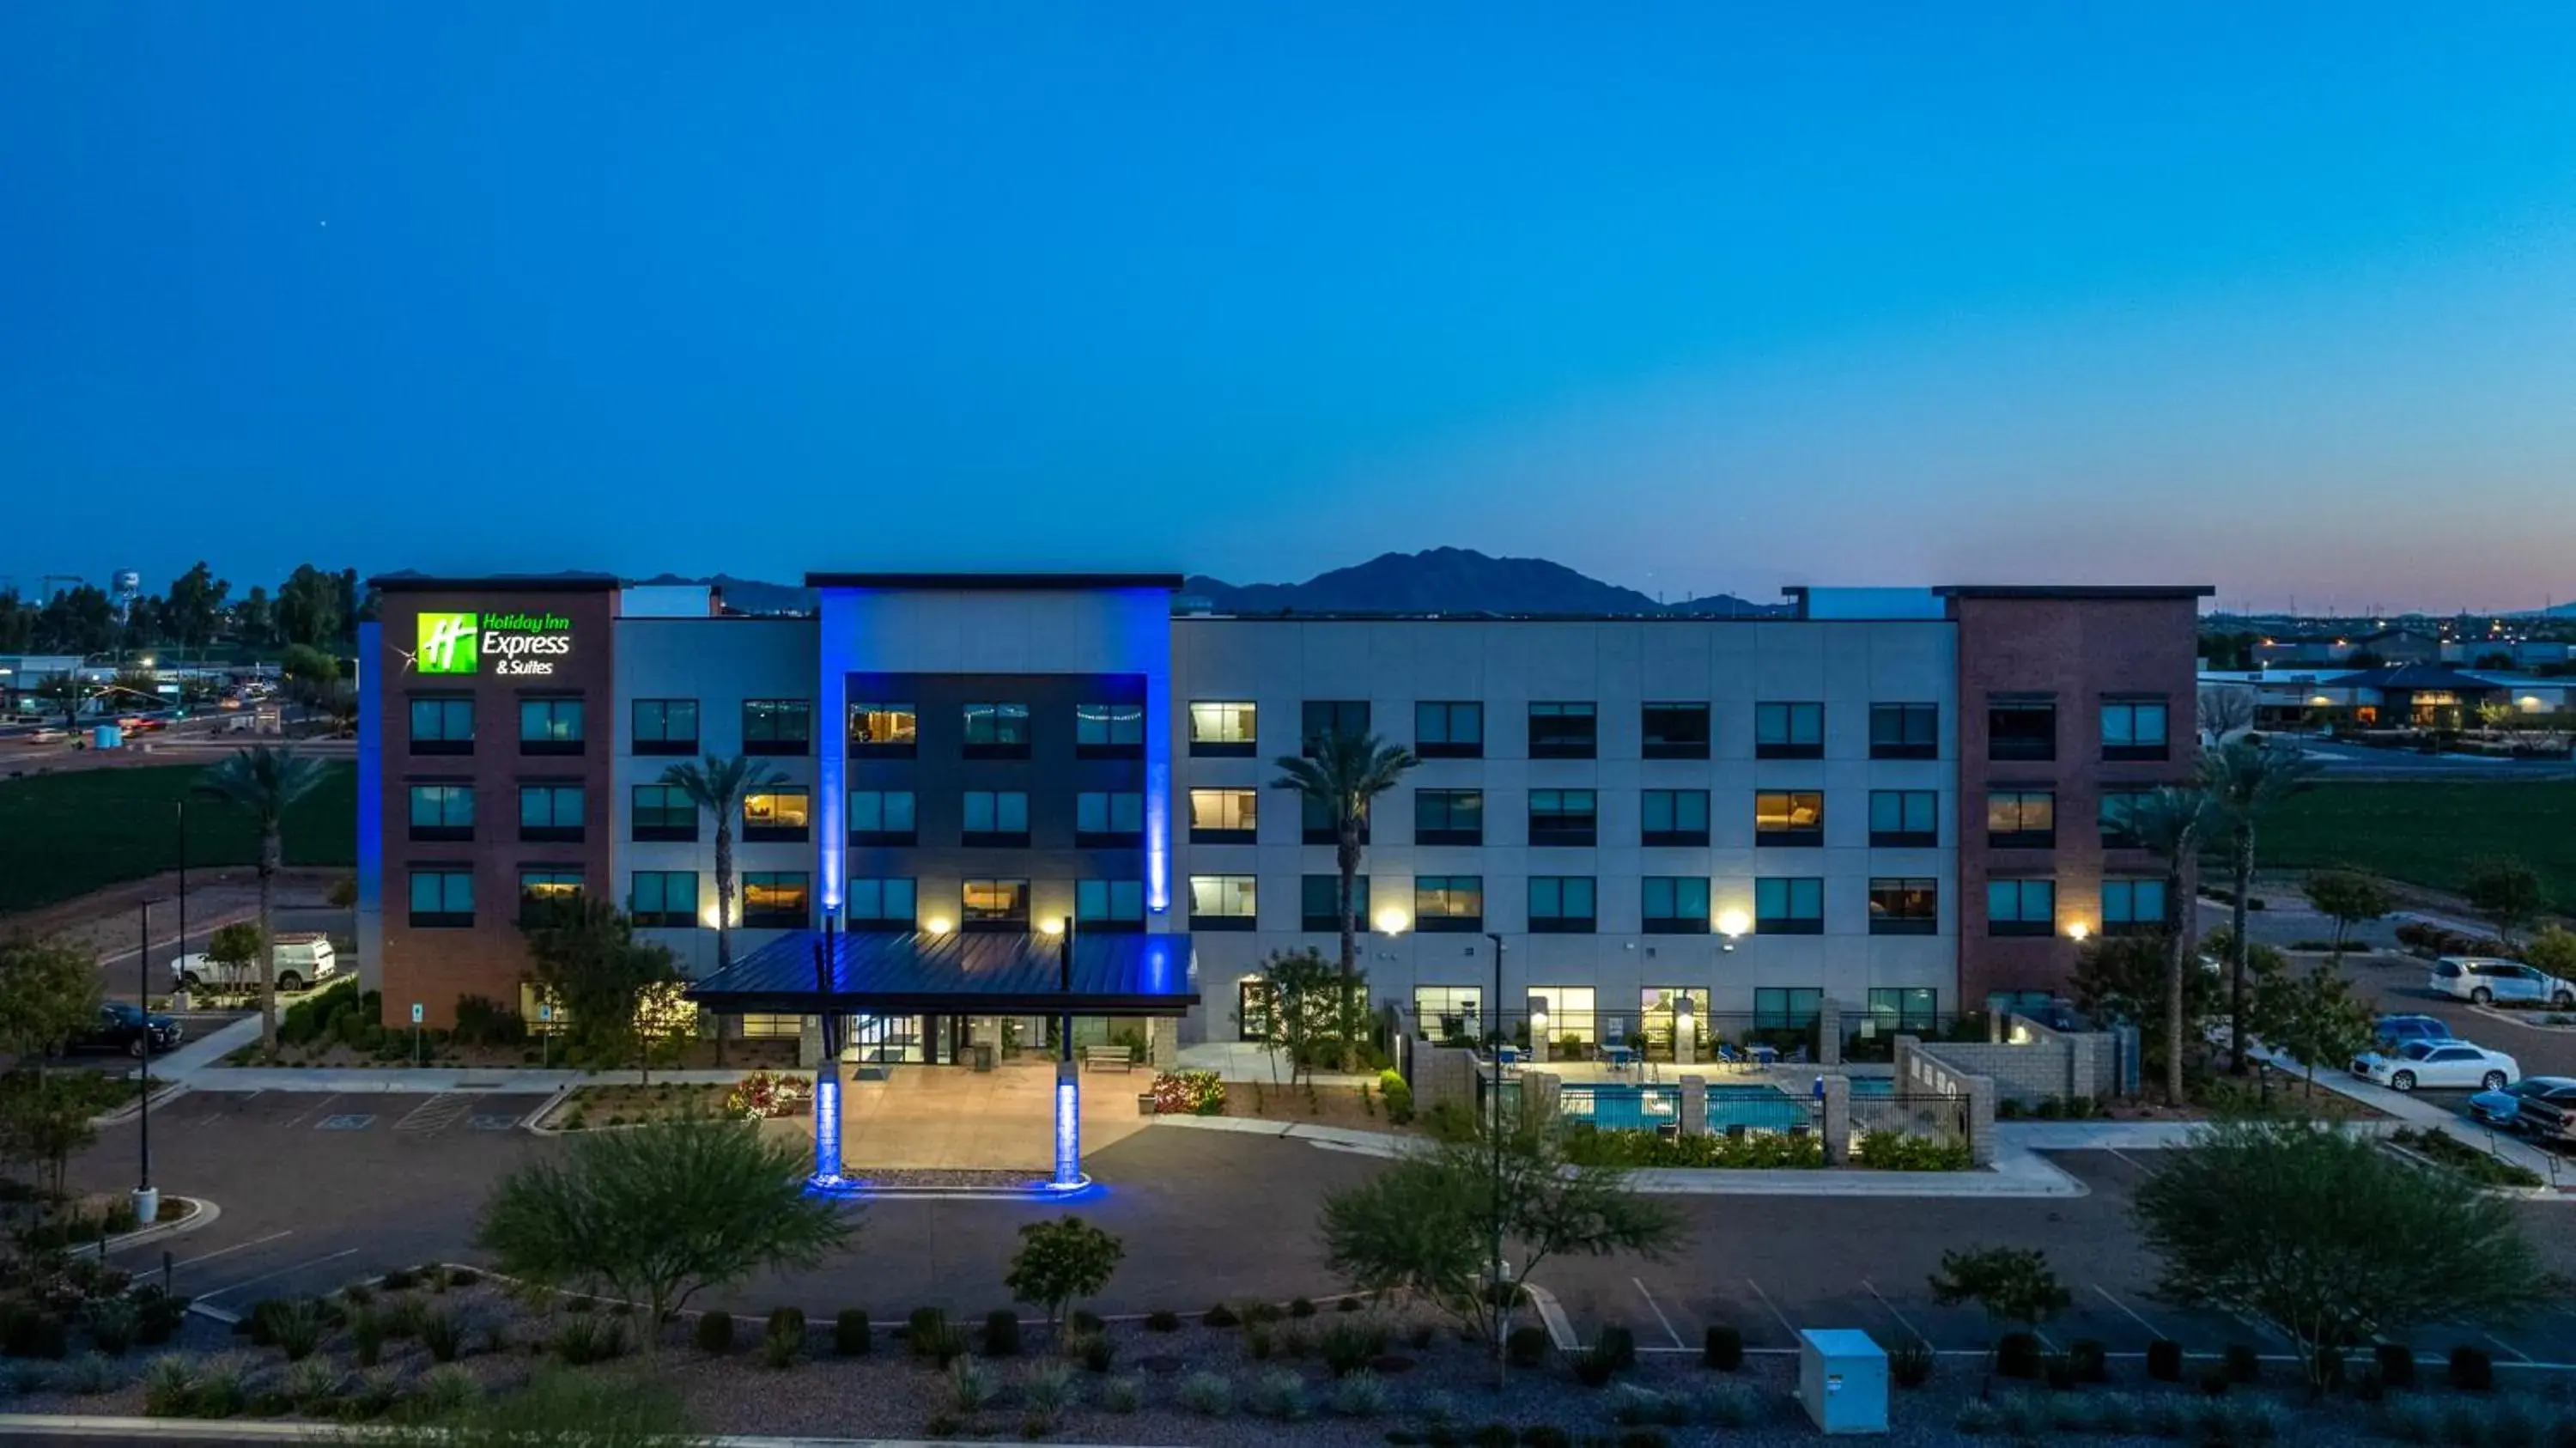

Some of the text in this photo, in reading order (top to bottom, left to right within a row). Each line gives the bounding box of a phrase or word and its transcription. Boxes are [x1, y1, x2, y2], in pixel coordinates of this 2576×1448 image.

[483, 612, 570, 633] Holiday Inn
[482, 631, 570, 659] Express
[495, 660, 553, 675] & Suites
